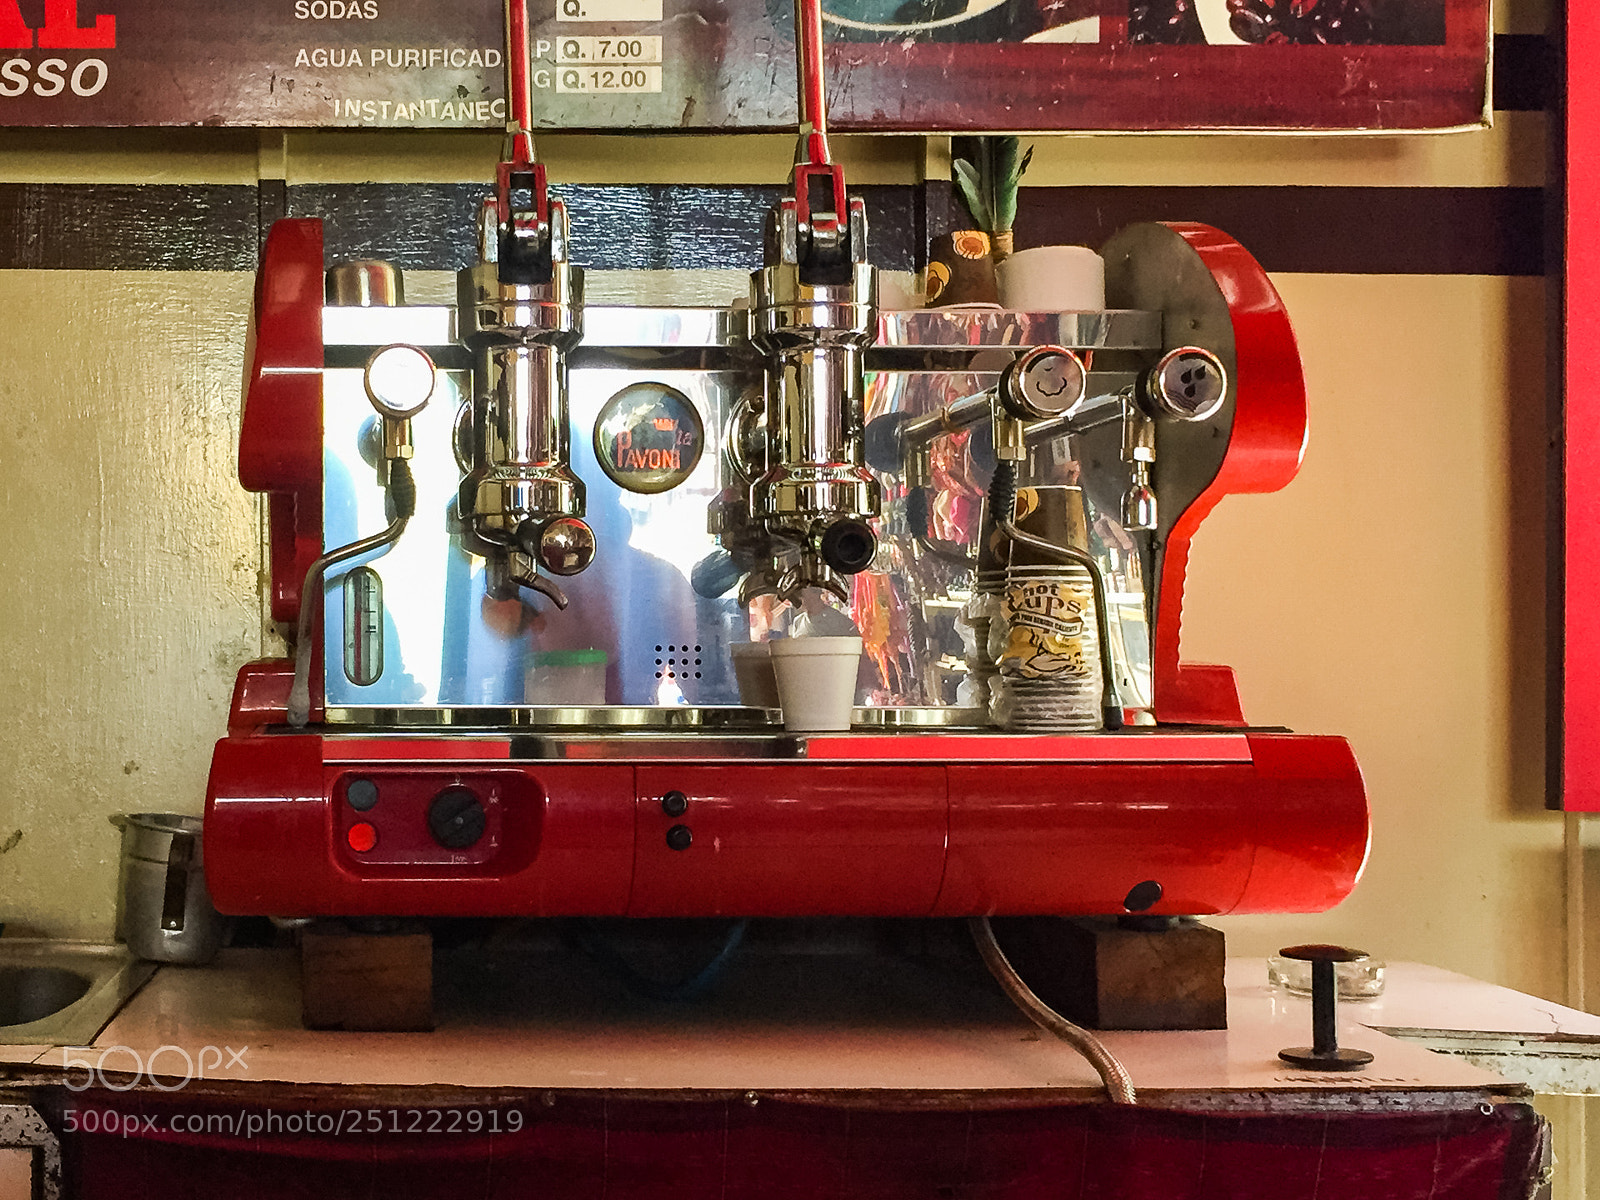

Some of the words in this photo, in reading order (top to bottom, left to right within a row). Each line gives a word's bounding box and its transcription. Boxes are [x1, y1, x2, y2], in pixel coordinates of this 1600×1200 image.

[294, 0, 379, 20] SODAS
[563, 0, 586, 17] Q.
[294, 48, 363, 68] AGUA
[370, 48, 505, 68] PURIFICAD
[535, 39, 552, 58] P
[562, 39, 586, 59] Q.
[598, 40, 642, 58] 7.00
[0, 58, 108, 97] SSO
[534, 69, 551, 88] G
[590, 70, 647, 88] 12.00
